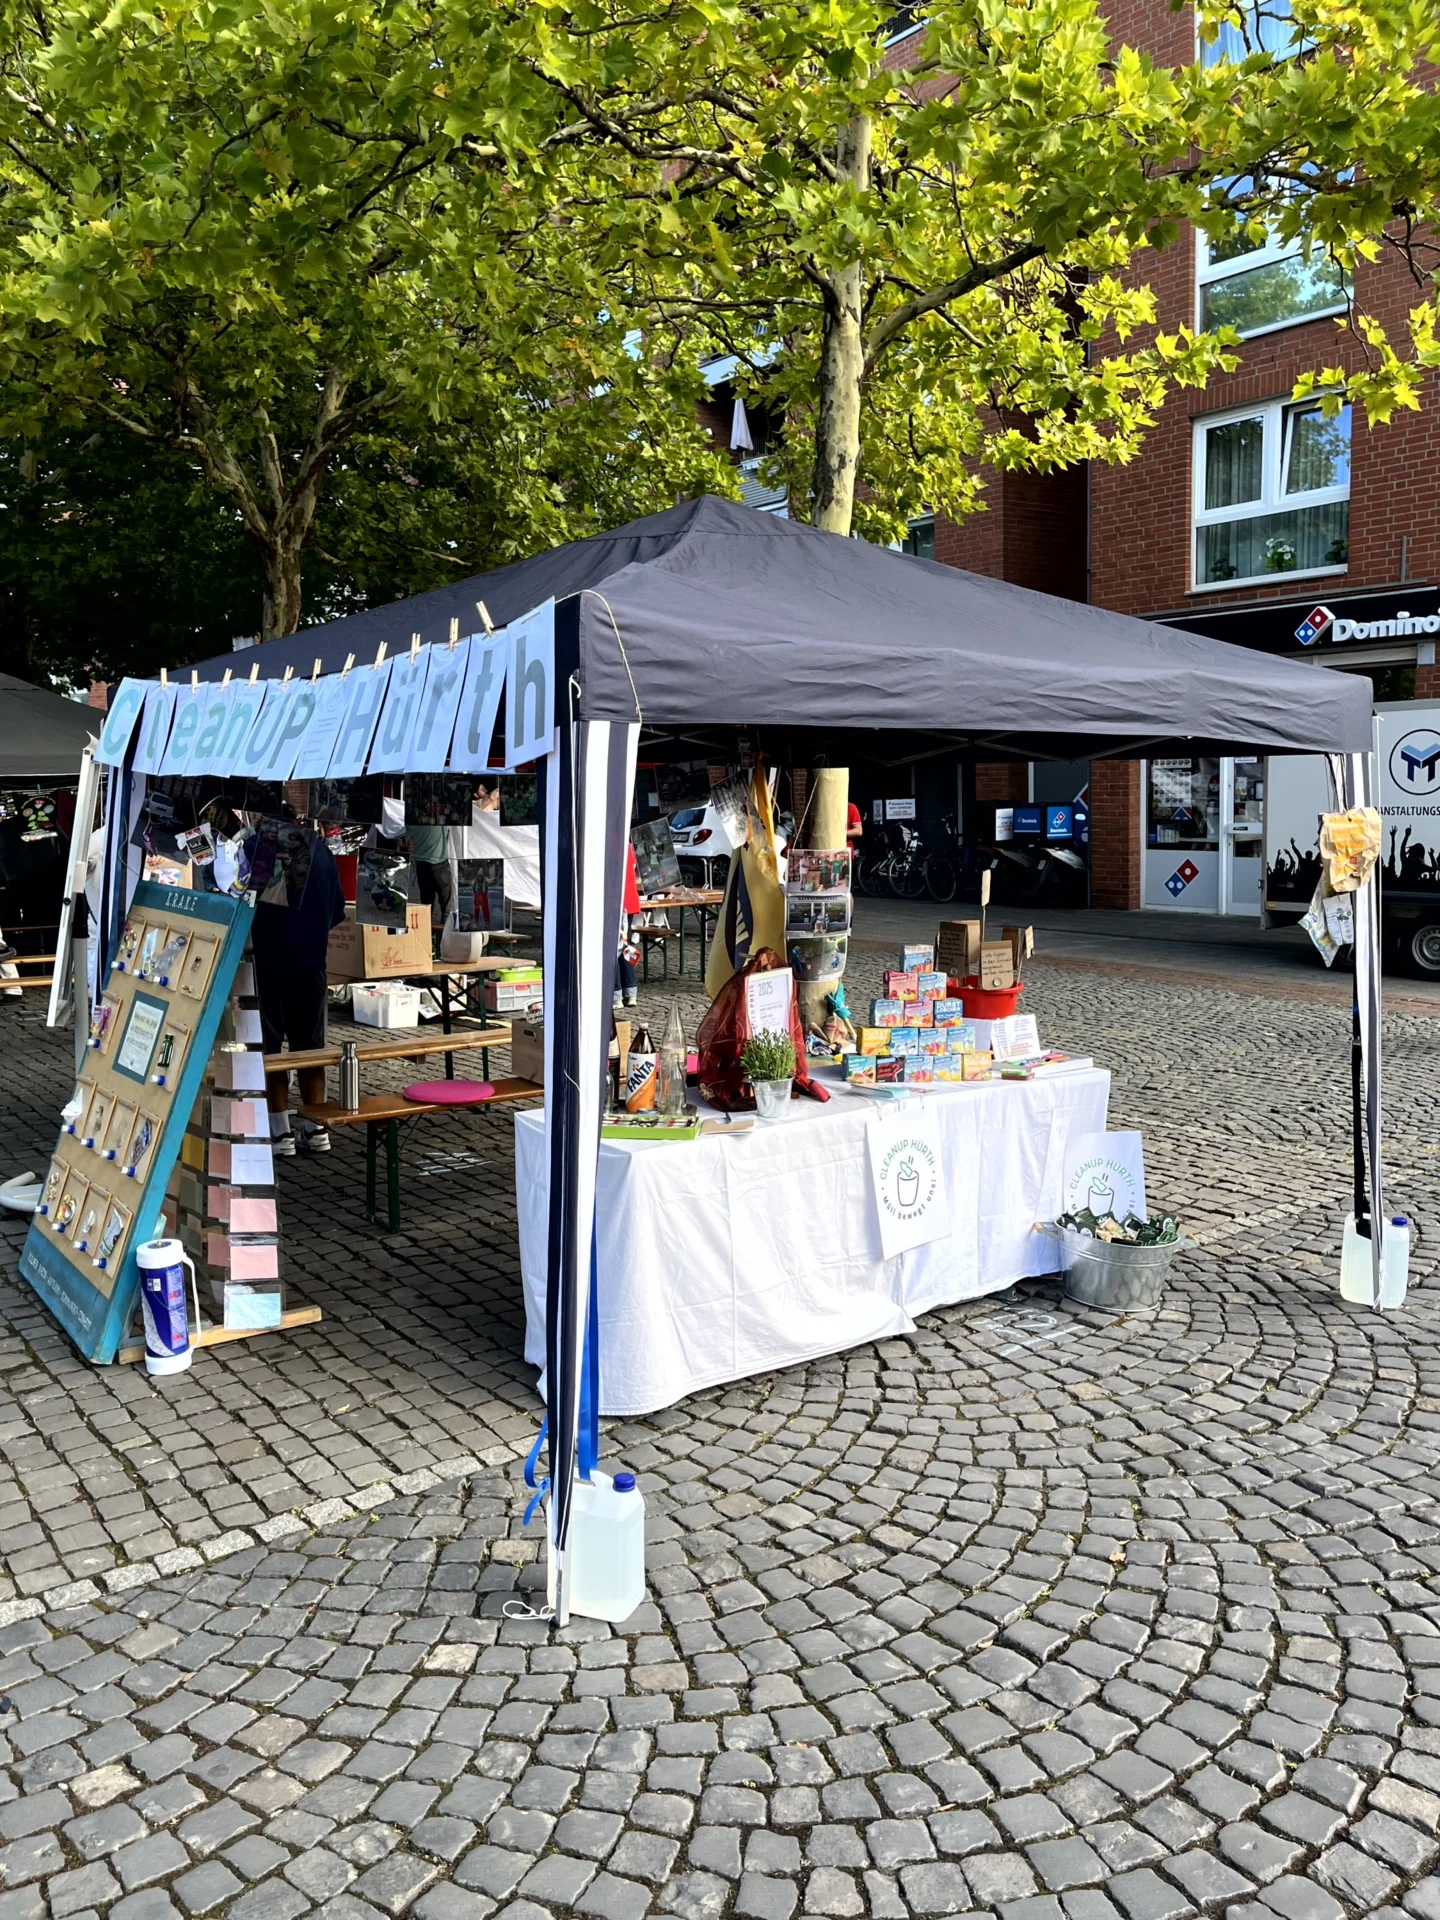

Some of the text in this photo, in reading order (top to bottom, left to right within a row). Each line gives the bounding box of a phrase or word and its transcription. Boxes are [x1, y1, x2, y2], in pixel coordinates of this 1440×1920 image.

[1332, 608, 1440, 642] Domino
[103, 688, 316, 769] CleanUP
[334, 635, 546, 764] Hürth
[758, 981, 773, 996] 2025
[627, 1060, 655, 1093] FANTA
[880, 1139, 935, 1180] CLEANUP HÜRTH
[1070, 1158, 1136, 1190] CLEANUP HÜRTH
[898, 1203, 926, 1220] bewegt
[926, 1179, 937, 1202] uns!
